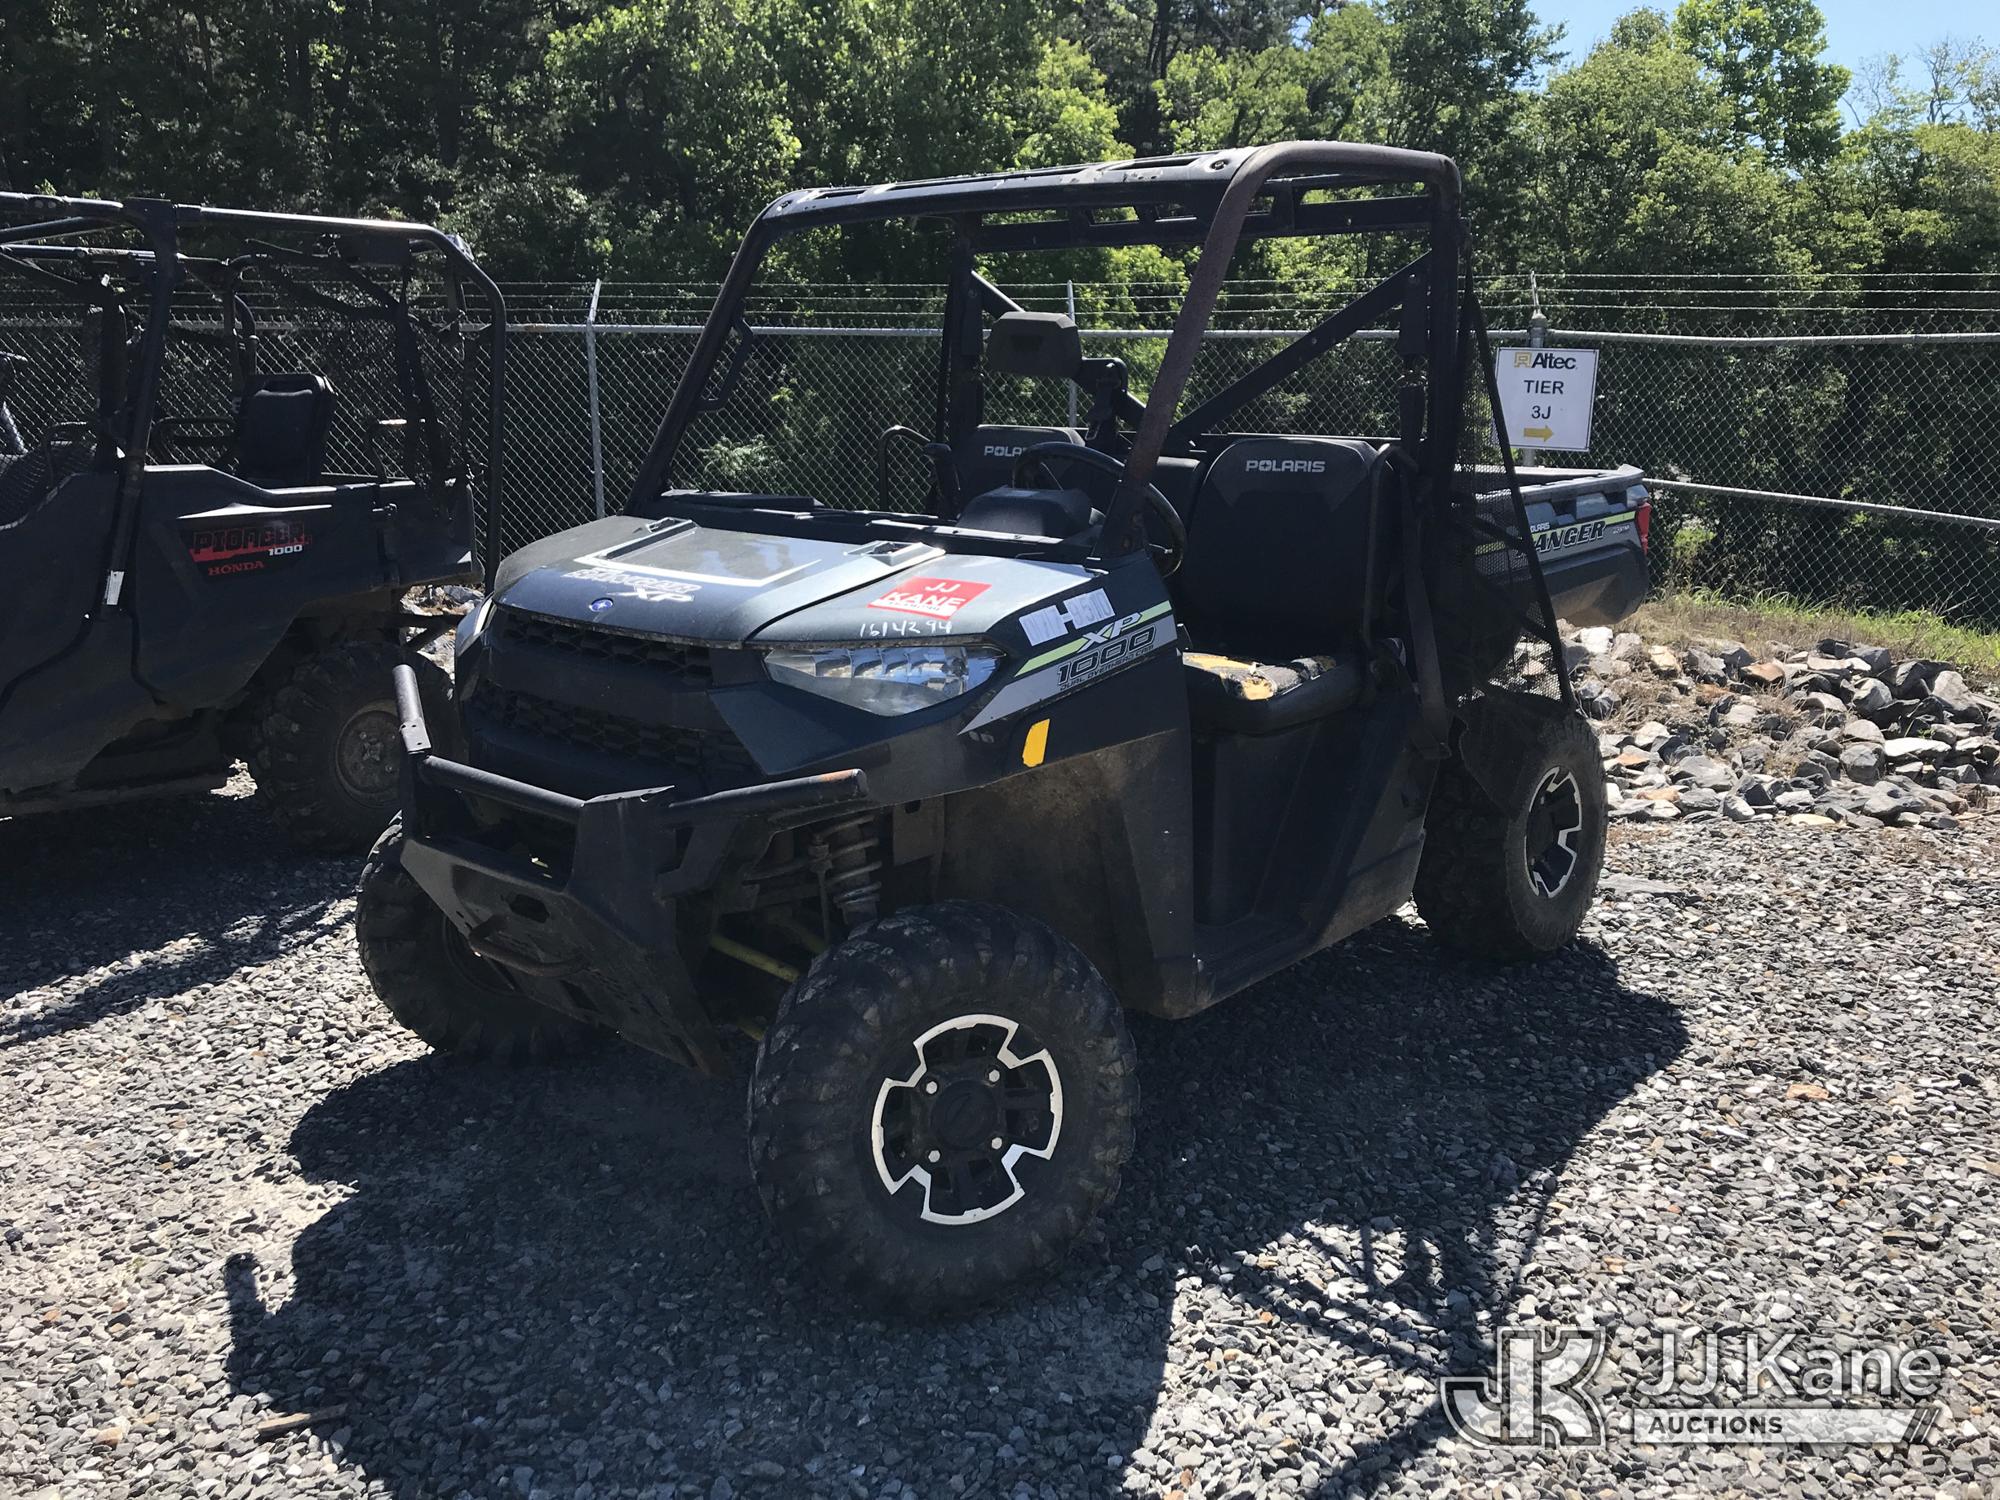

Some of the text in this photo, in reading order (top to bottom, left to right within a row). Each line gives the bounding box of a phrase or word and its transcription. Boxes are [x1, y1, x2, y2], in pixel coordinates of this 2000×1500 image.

[1531, 352, 1577, 369] Altec
[1523, 379, 1565, 395] TIER
[1531, 405, 1552, 420] 3J
[984, 445, 1028, 457] POLA
[1245, 459, 1326, 473] POLARIS
[1530, 521, 1551, 532] OLARIS
[1533, 520, 1607, 554] ANGER
[268, 544, 303, 556] 1000
[208, 561, 265, 576] HONDA
[924, 582, 962, 593] JJ
[881, 591, 968, 607] KANE
[1077, 612, 1143, 654] XP
[1057, 624, 1157, 686] 1000
